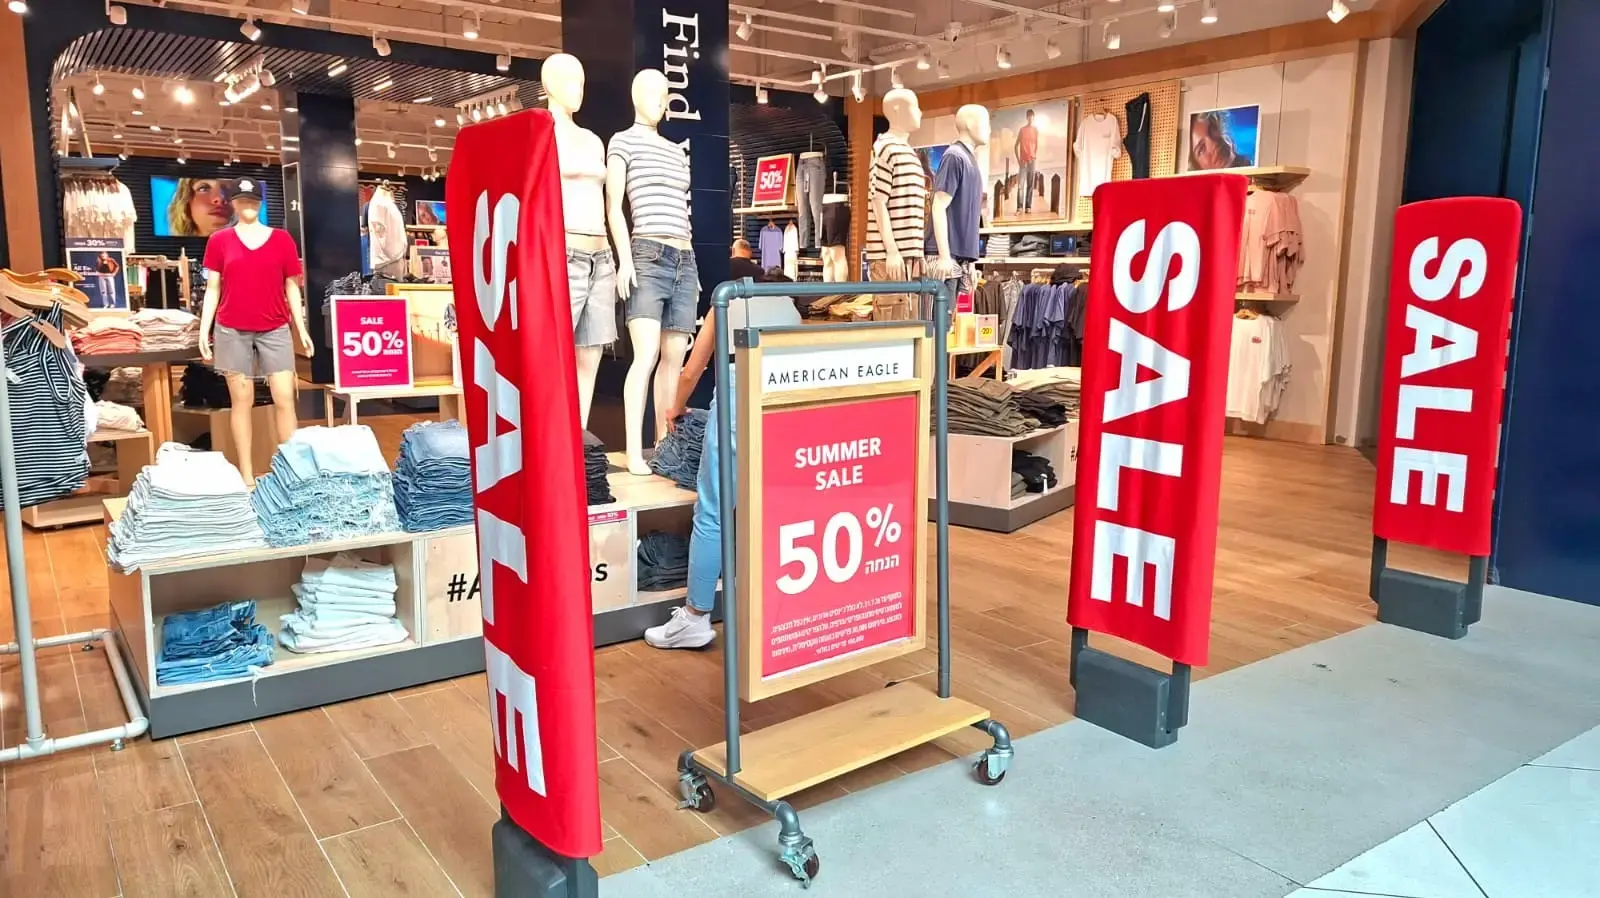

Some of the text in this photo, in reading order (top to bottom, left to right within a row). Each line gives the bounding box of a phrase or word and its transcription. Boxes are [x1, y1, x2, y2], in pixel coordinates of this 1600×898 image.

[662, 8, 701, 121] Find
[360, 316, 384, 325] SALE
[342, 330, 404, 357] 50%
[768, 362, 899, 385] AMERICAN EAGLE
[1390, 236, 1488, 513] SALE
[1091, 219, 1201, 621] SALE
[794, 437, 882, 469] SUMMER
[473, 189, 547, 798] SALE
[815, 464, 864, 491] SALE
[775, 502, 902, 595] 50%
[864, 554, 900, 575] הנחה
